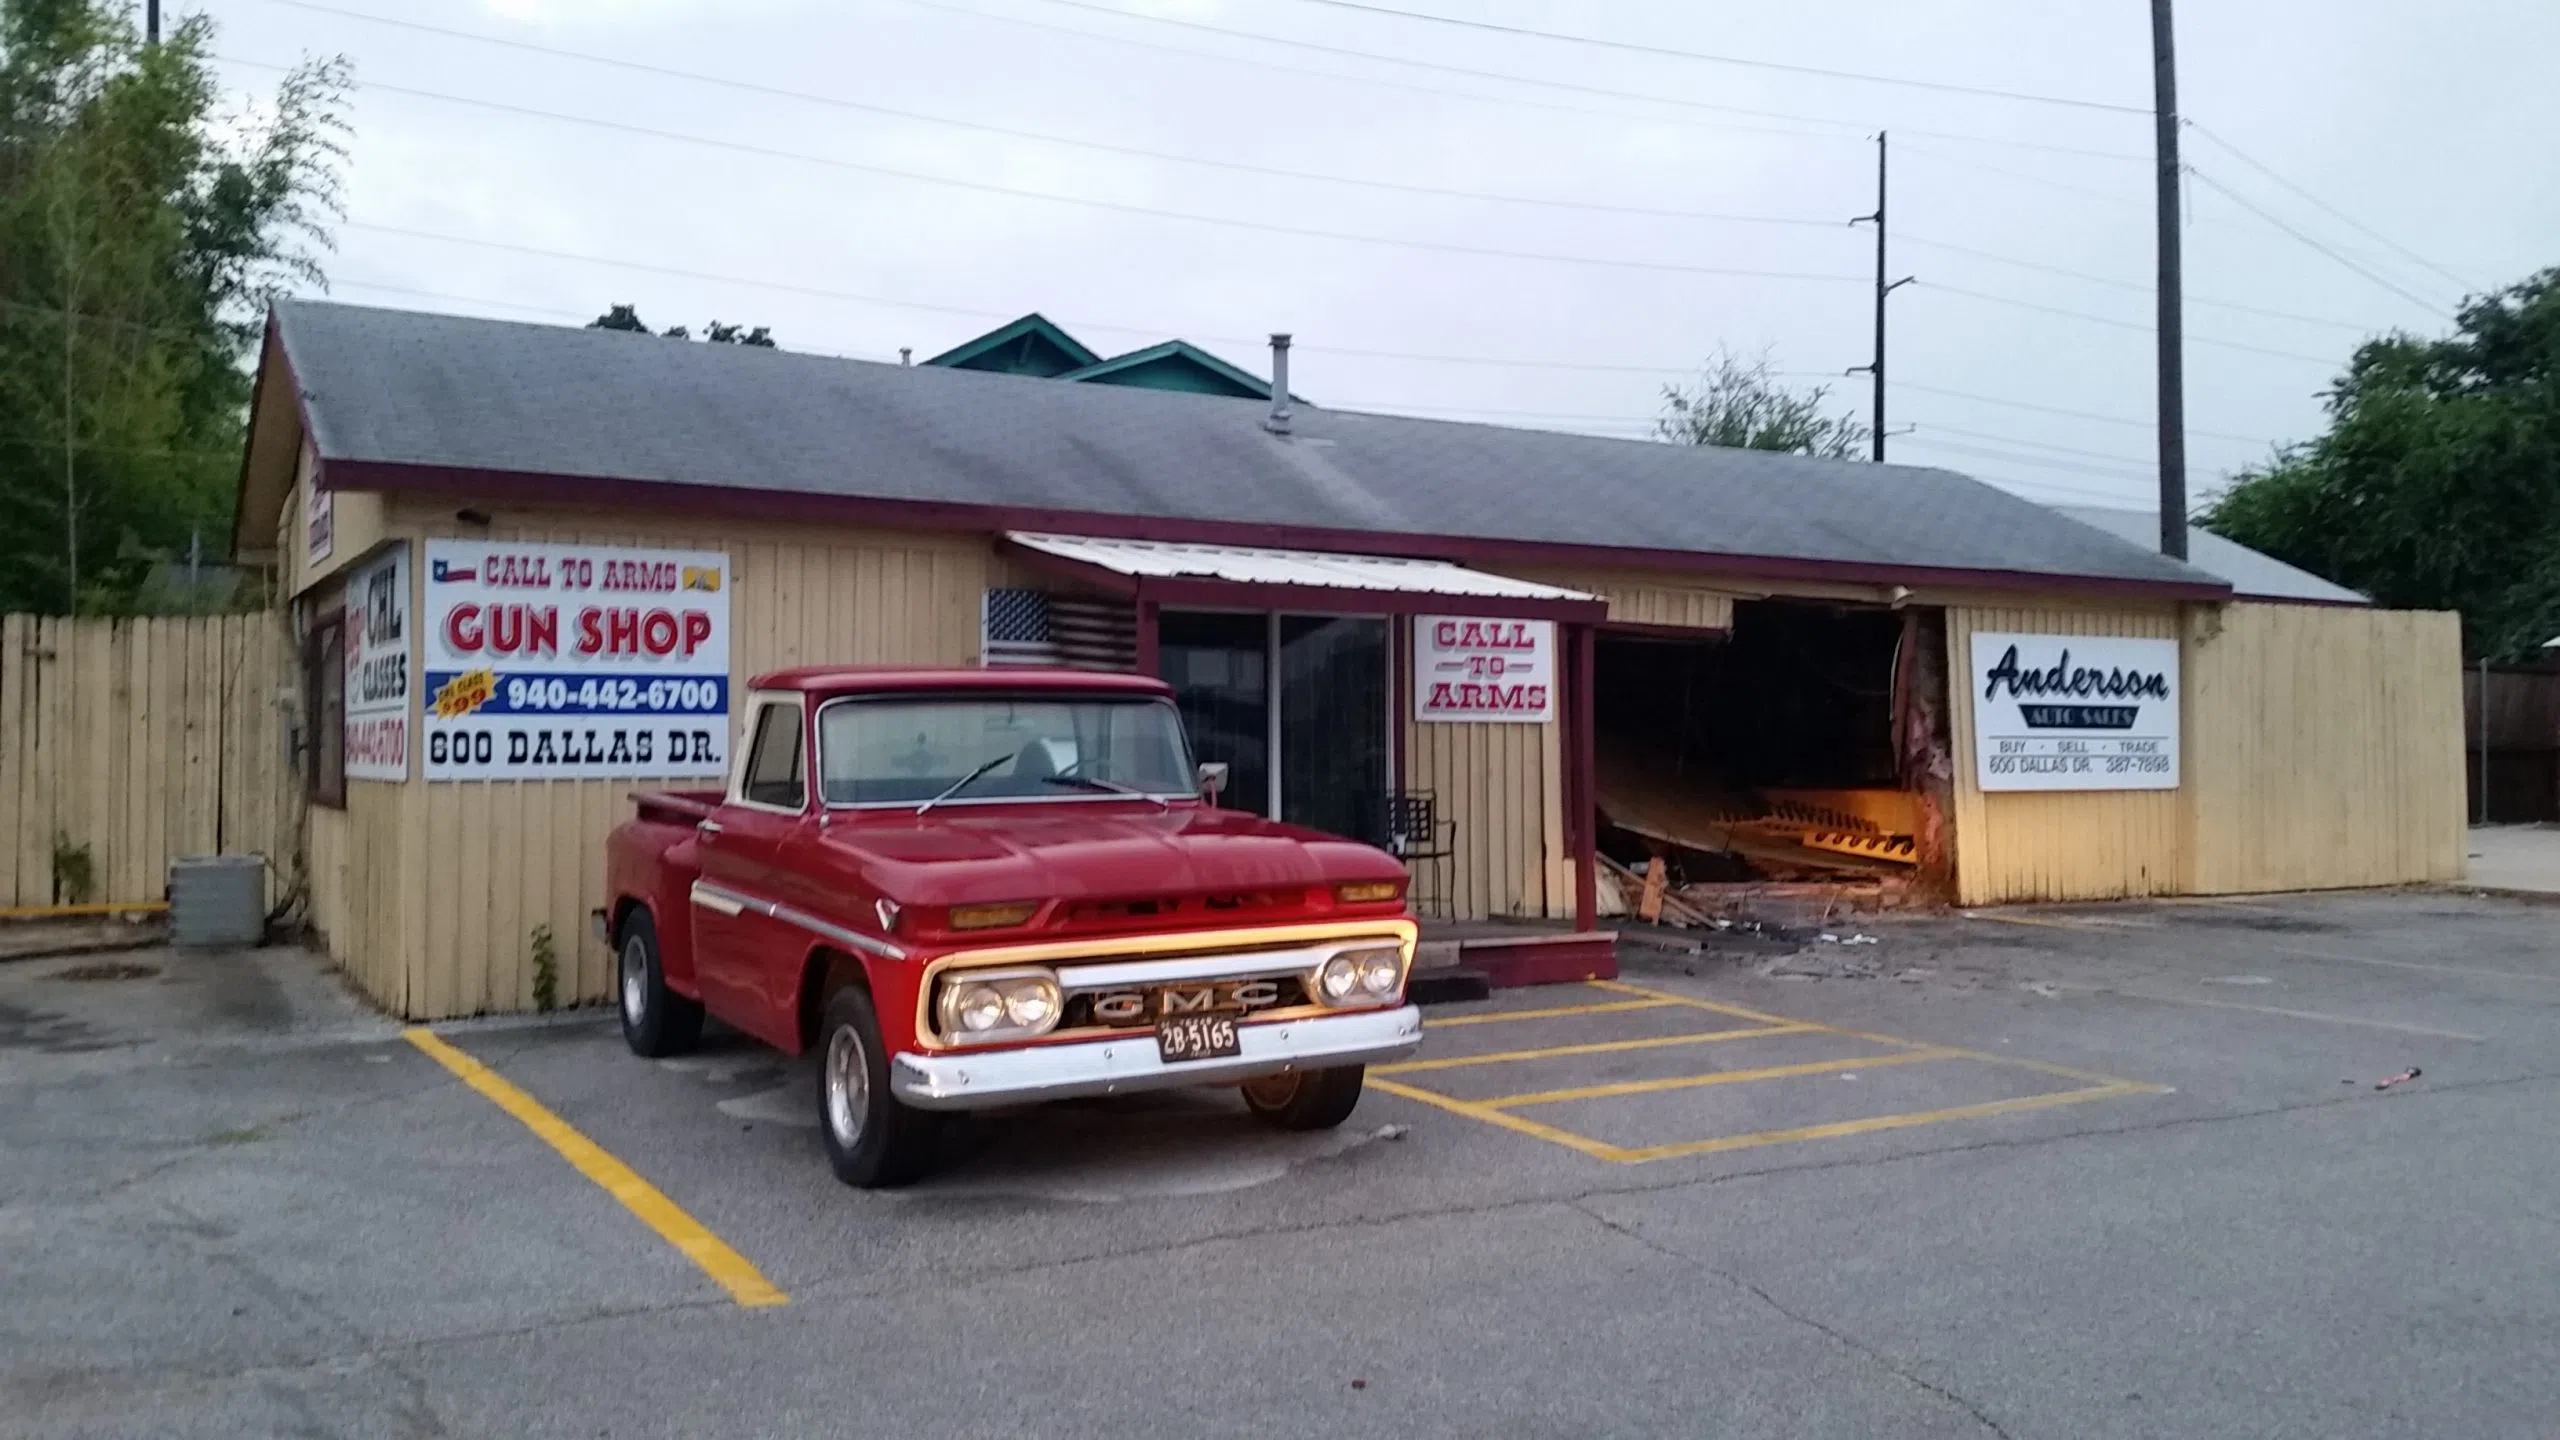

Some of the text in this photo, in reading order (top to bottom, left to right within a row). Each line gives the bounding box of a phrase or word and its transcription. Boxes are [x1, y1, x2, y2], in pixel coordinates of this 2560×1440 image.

[485, 555, 677, 592] CALL TO ARMS
[367, 564, 402, 649] CHL
[444, 601, 712, 657] GUN SHOP
[1436, 621, 1535, 649] CALL
[362, 652, 406, 703] CLASSES
[1470, 656, 1505, 676] TO
[1985, 643, 2170, 701] Anderson
[507, 678, 719, 711] 940-442-6700
[1428, 683, 1547, 710] ARMS
[2029, 708, 2134, 727] AUTO SALES
[430, 731, 722, 764] 600 DALLAS DR.
[1999, 741, 2159, 755] BUY SELL TRADE
[1989, 757, 2015, 774] 600
[2020, 757, 2068, 774] DALLAS
[1094, 982, 1279, 1019] GMC
